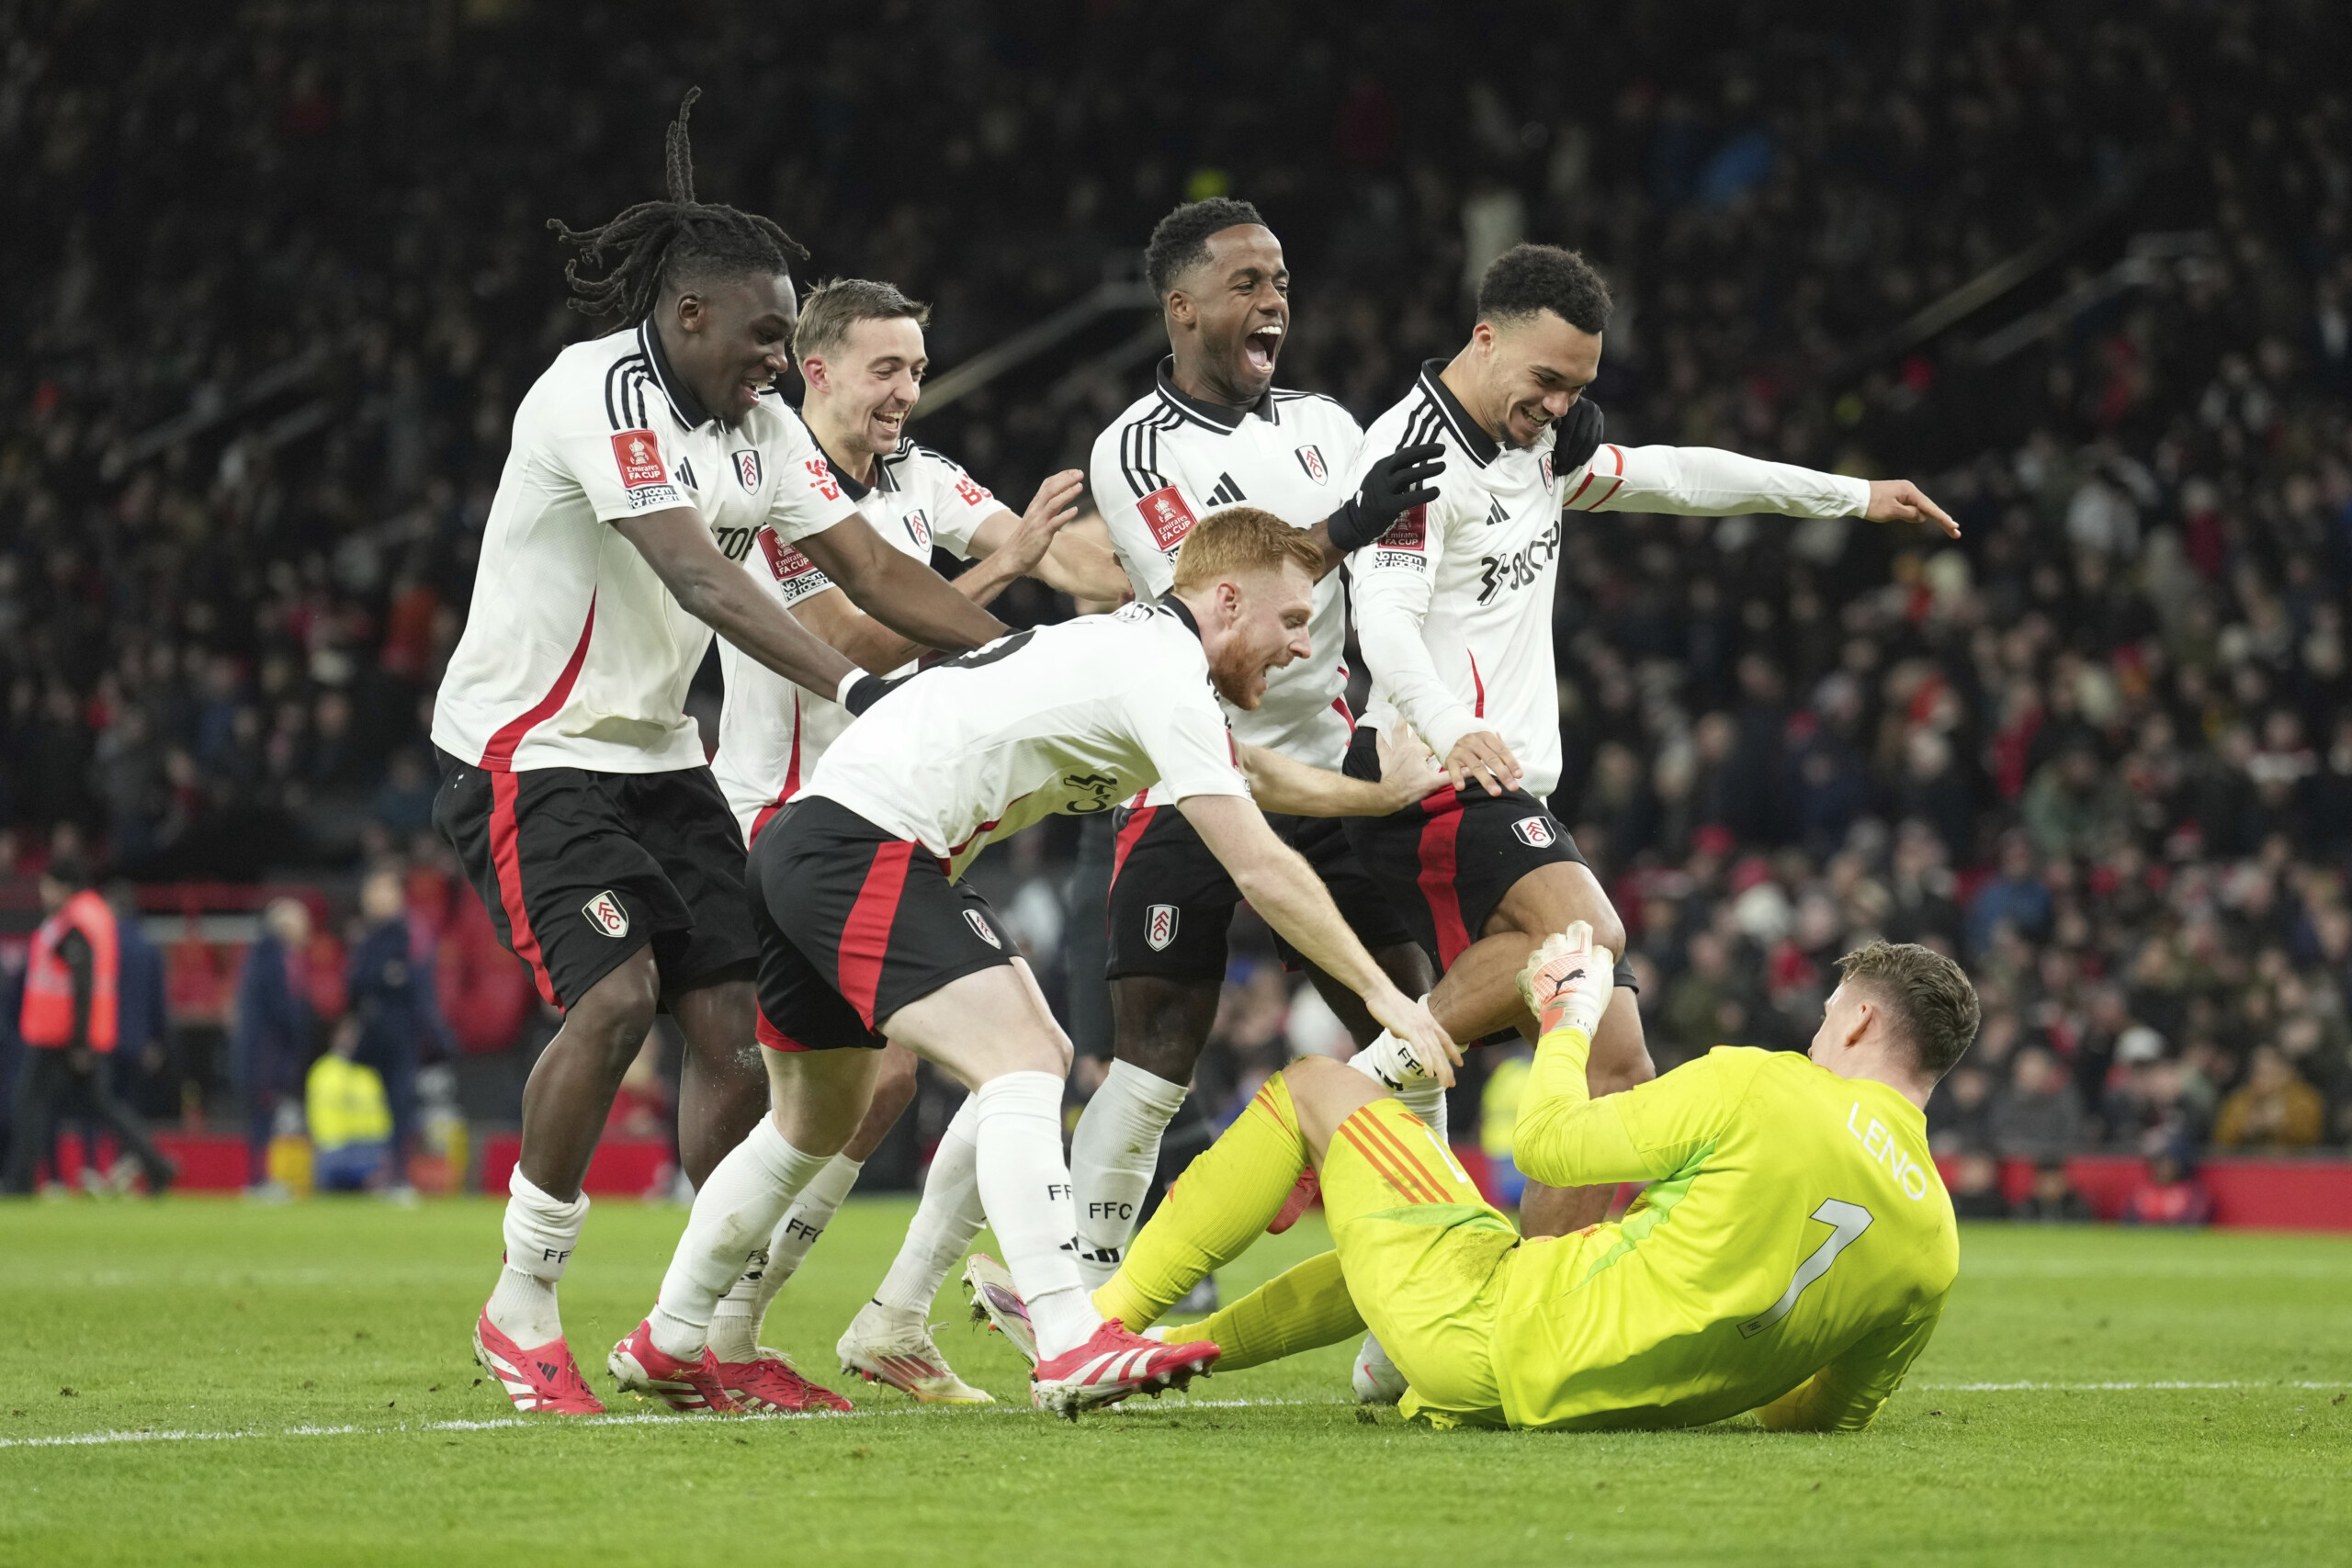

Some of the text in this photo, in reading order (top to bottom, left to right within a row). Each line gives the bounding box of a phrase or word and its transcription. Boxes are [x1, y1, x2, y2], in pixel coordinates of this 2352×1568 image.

[627, 464, 659, 473] Emirates
[742, 456, 756, 486] FFC
[1306, 450, 1323, 478] FFC
[628, 470, 661, 480] FA CUP
[626, 487, 673, 500] No room
[628, 494, 681, 509] for racism
[912, 515, 928, 544] FFC
[1158, 514, 1188, 535] Emirates
[1161, 520, 1191, 542] FA CUP
[775, 553, 805, 568] Emirate
[779, 557, 809, 575] FA CUP
[1374, 551, 1422, 565] No room
[1374, 560, 1425, 574] for racism
[781, 571, 825, 592] No room
[1526, 821, 1546, 842] FFC
[598, 901, 620, 930] FFC
[1154, 910, 1170, 942] FFC
[1397, 1047, 1428, 1077] FF
[1847, 1101, 1927, 1201] LENO
[1089, 1201, 1133, 1220] FFC
[543, 1247, 572, 1264] FF
[1736, 1197, 1874, 1339] 1
